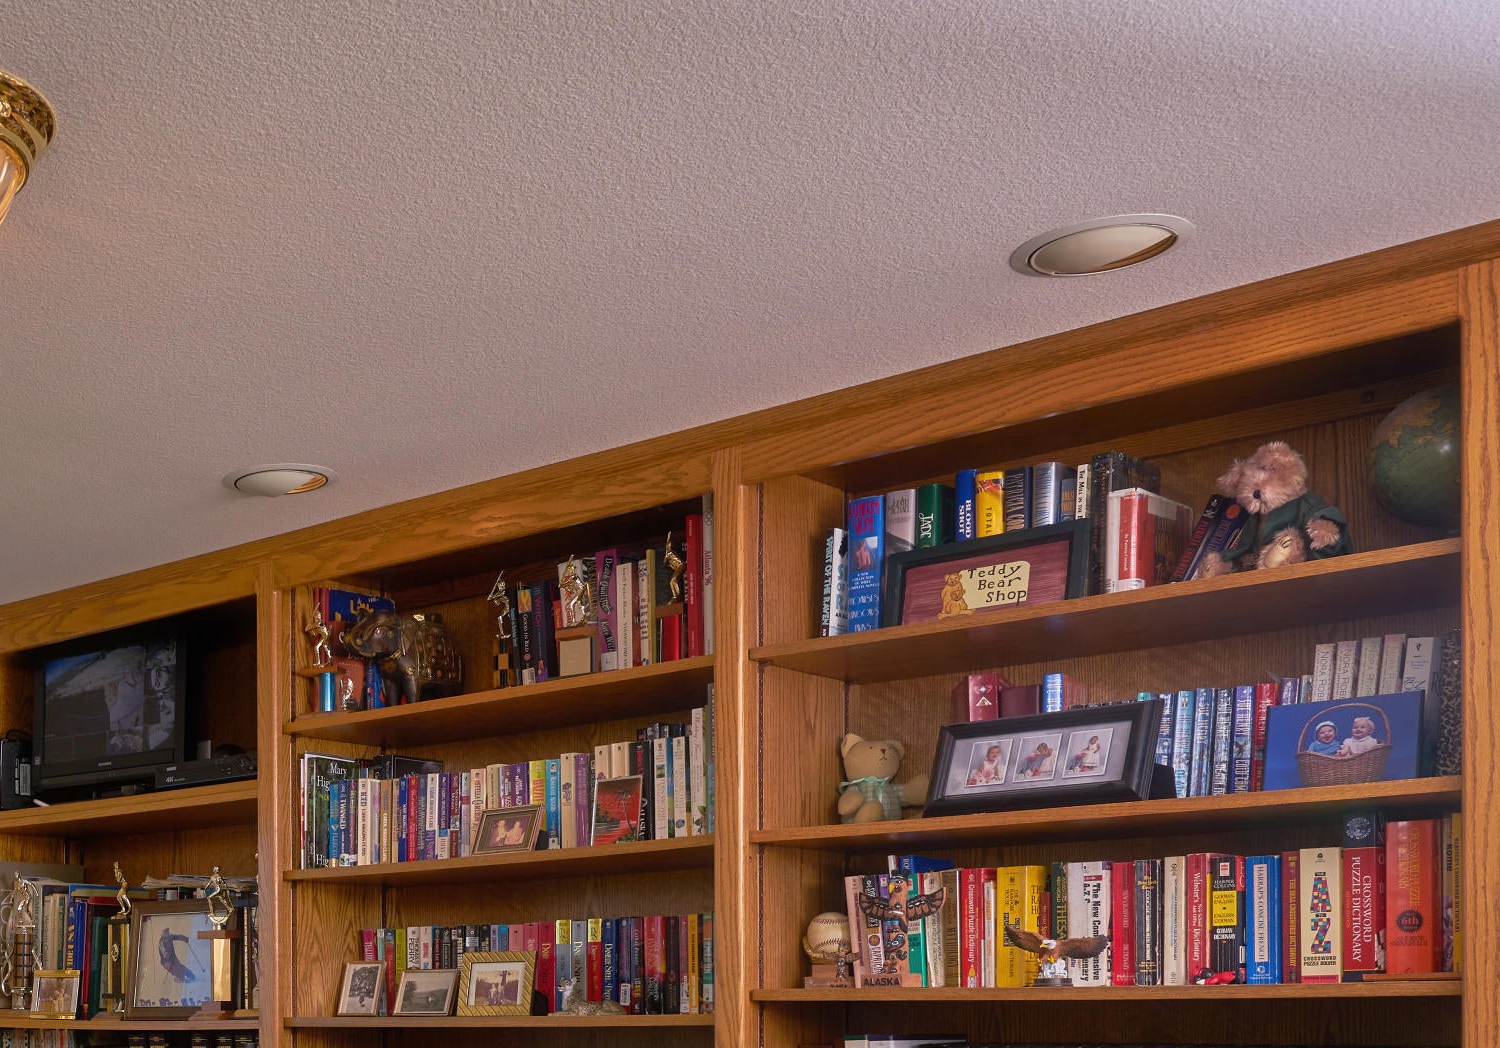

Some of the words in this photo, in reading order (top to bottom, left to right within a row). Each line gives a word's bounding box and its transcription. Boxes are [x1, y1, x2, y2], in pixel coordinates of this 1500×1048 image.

[704, 550, 712, 575] Atlanta
[967, 564, 1022, 579] Teddy
[823, 578, 831, 595] THE
[978, 576, 1021, 591] Bear
[985, 590, 1027, 607] Shop
[330, 762, 347, 775] Mary
[1352, 857, 1361, 894] PUZZLE
[1362, 875, 1372, 943] CROSSWORD
[1056, 904, 1067, 939] THESA
[1352, 898, 1362, 962] DICTIONARY
[967, 934, 975, 963] Dictionary
[863, 976, 900, 987] ALASKA
